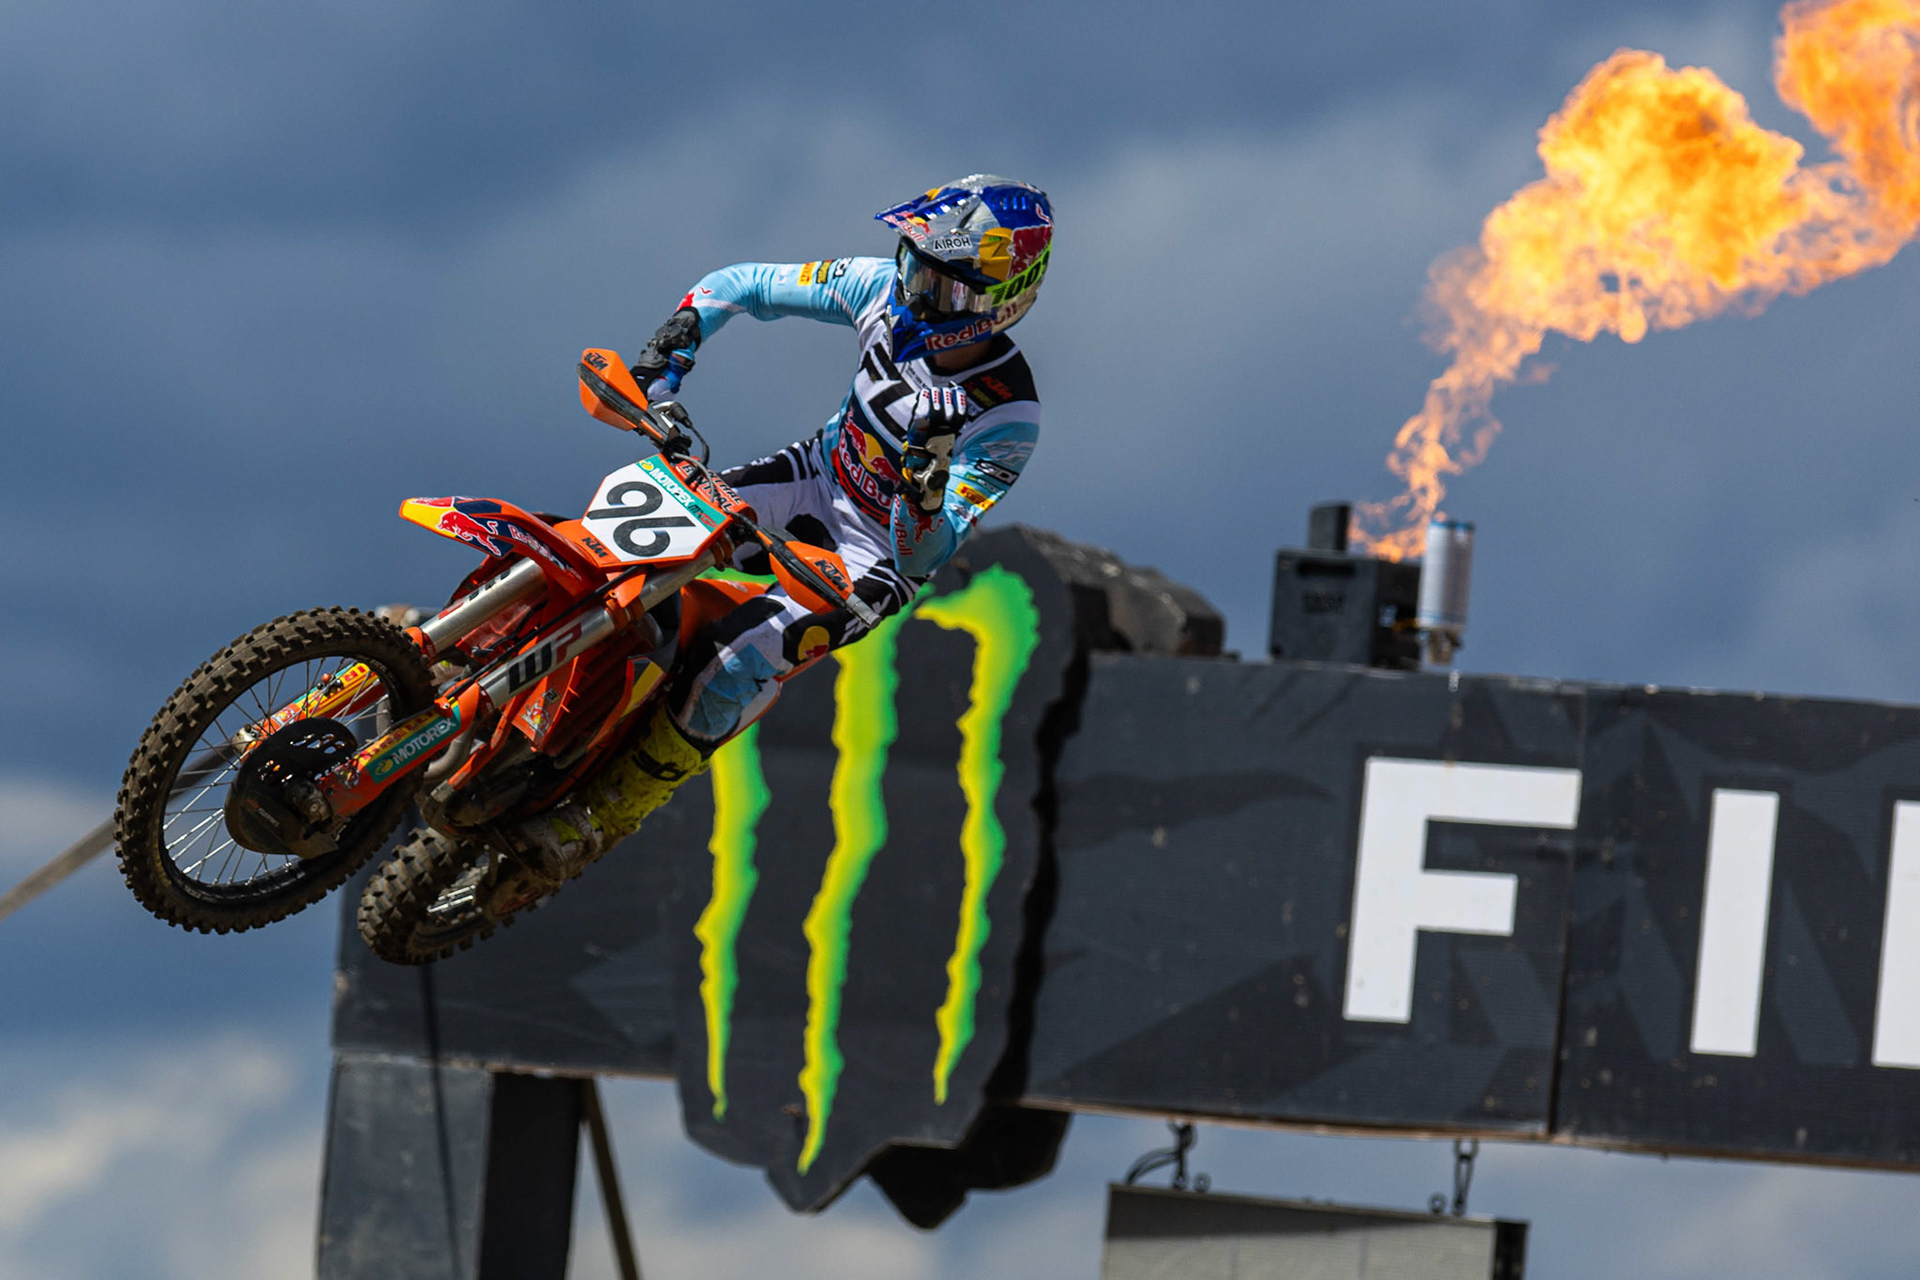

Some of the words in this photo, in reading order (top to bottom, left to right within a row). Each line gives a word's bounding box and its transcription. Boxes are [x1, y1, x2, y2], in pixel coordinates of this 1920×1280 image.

[934, 237, 972, 250] AIROH
[925, 324, 975, 350] Red
[976, 302, 1018, 334] Bull
[584, 352, 609, 371] KTM
[861, 472, 893, 510] Bu
[587, 481, 696, 557] 96
[581, 537, 609, 558] KTM
[814, 559, 849, 592] KTM
[392, 718, 456, 765] MOTOREX
